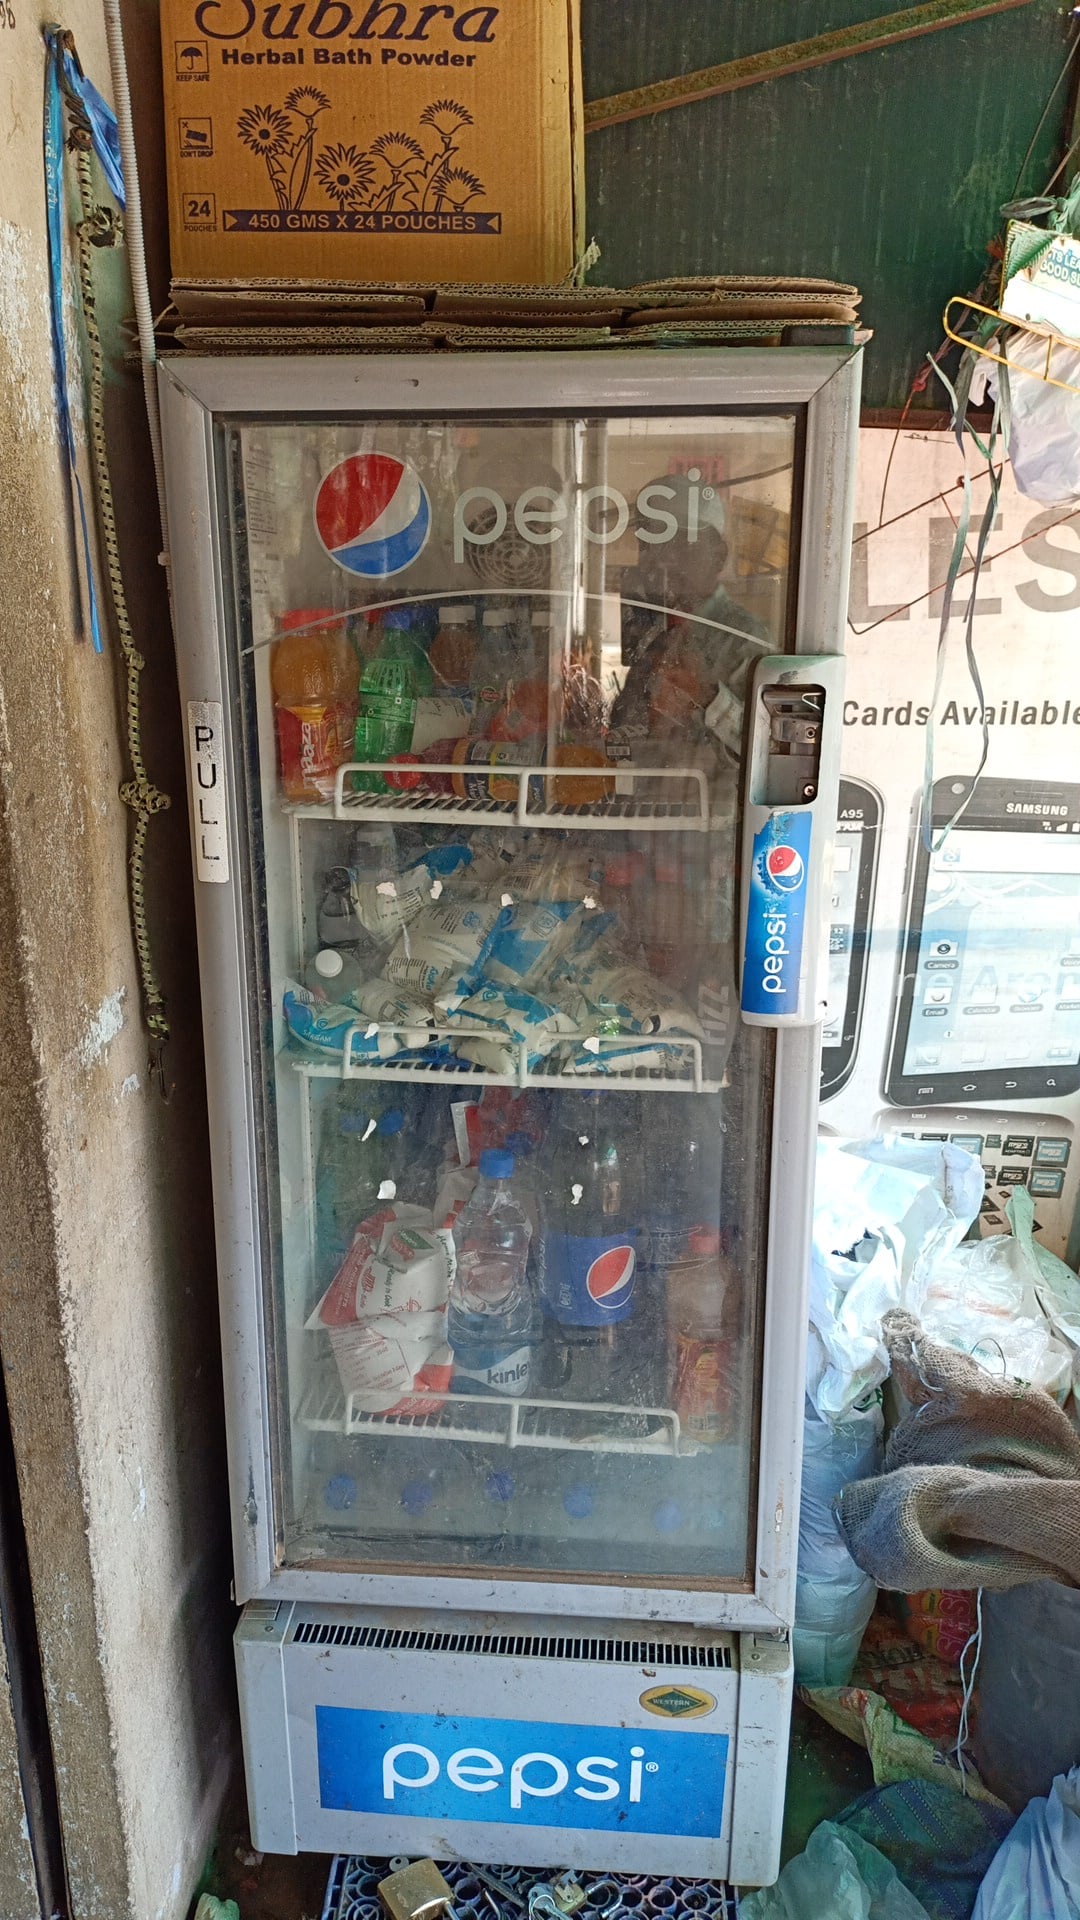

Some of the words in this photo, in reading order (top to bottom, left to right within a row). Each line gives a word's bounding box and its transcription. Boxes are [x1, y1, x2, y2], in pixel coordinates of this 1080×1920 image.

[222, 48, 304, 65] Herbal
[313, 48, 372, 65] Bath
[381, 48, 476, 67] Powder
[176, 74, 193, 82] KEEP
[188, 200, 211, 217] 24
[249, 214, 280, 229] 450
[286, 214, 330, 229] GMS
[336, 215, 348, 229] X
[354, 215, 376, 229] 24
[382, 215, 476, 230] POUCHES
[453, 468, 702, 564] pepsi
[843, 700, 930, 726] Cards
[195, 725, 221, 861] PULL
[1006, 803, 1068, 816] SAMSUNG
[762, 912, 790, 993] pepsi
[382, 1743, 645, 1809] pepsi
